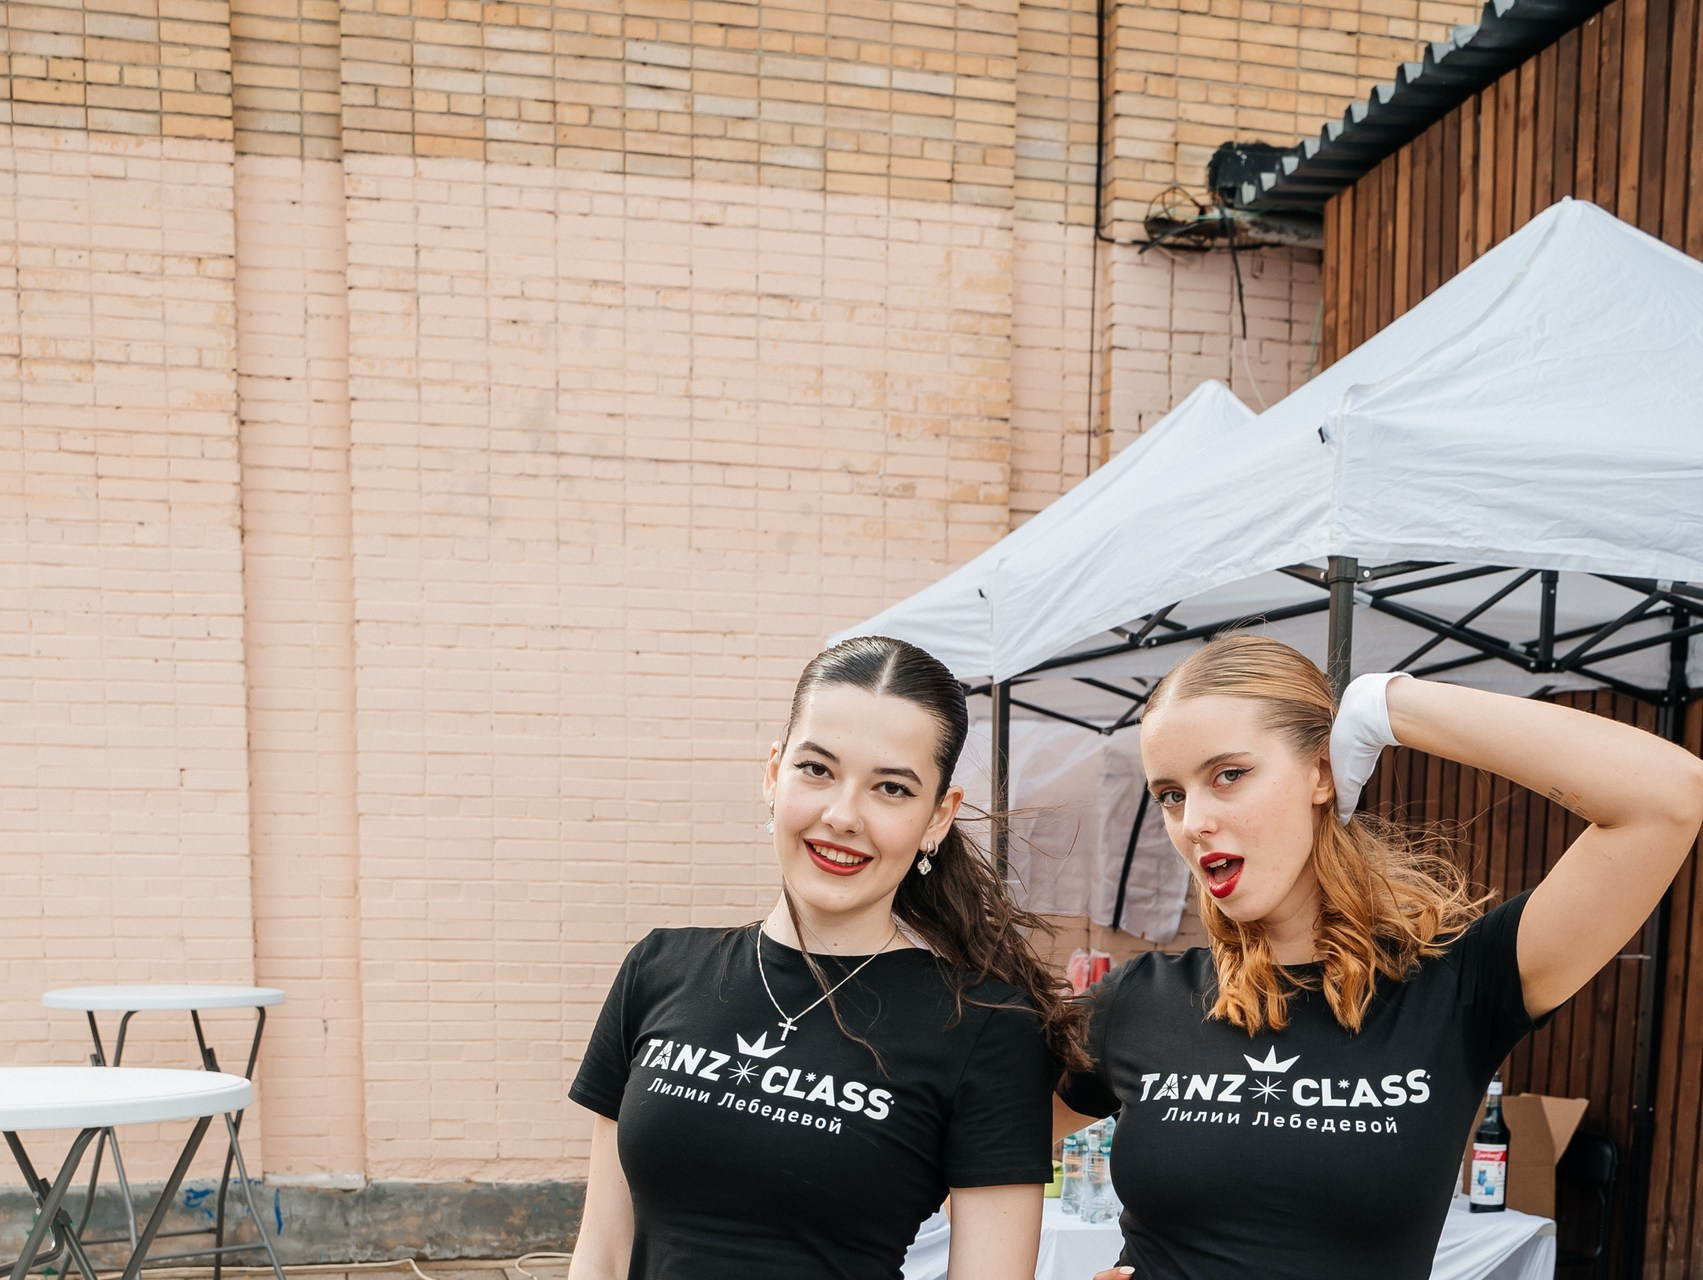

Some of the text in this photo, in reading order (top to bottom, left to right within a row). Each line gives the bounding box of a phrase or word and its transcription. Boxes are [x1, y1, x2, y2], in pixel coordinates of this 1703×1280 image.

[640, 1039, 894, 1120] TANZ CLASS
[1139, 1069, 1431, 1107] TANZ CLASS
[646, 1078, 842, 1135] Лилии Лебедевой
[1161, 1107, 1398, 1134] Лилии Лебедевой
